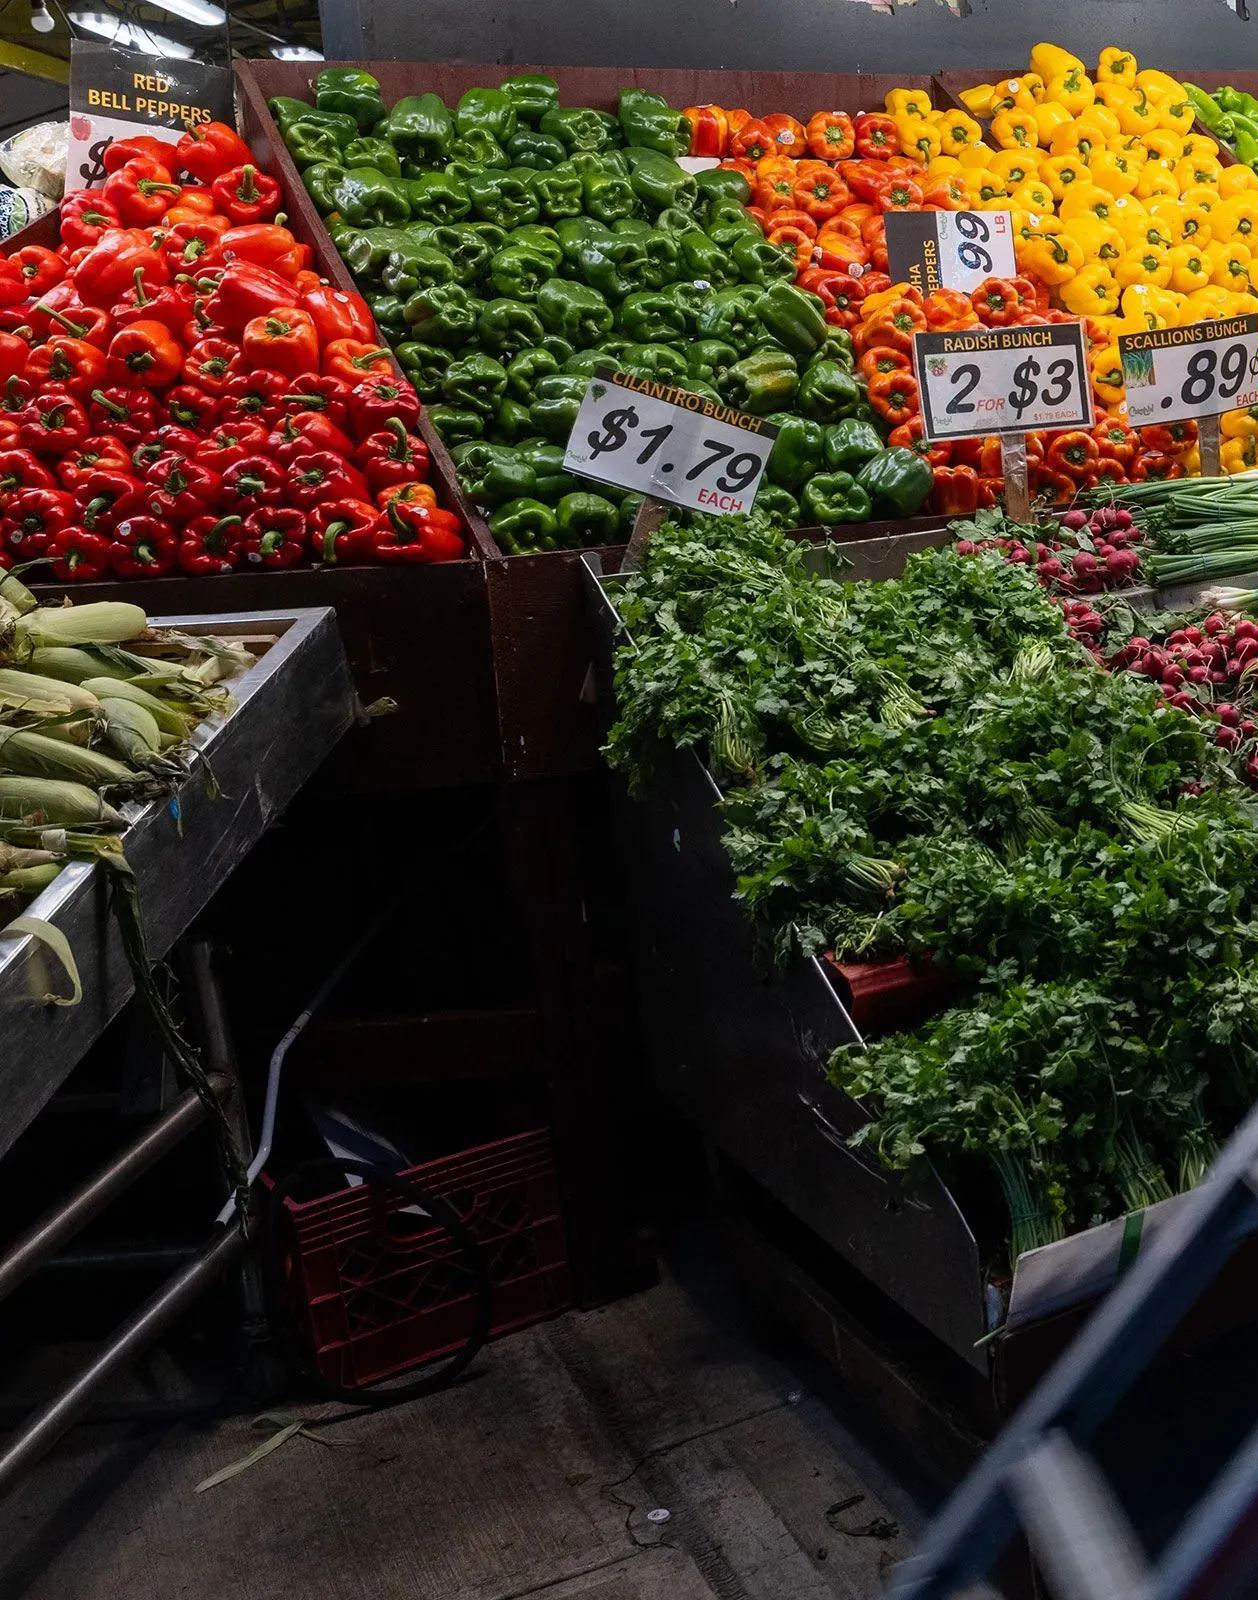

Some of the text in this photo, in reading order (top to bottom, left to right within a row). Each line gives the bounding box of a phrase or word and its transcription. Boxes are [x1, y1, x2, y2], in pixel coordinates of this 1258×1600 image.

[133, 73, 169, 93] RED
[88, 89, 212, 124] BELL PEPPERS
[994, 215, 1006, 234] LB
[923, 239, 939, 297] EPPERS
[943, 331, 1052, 352] RADISH BUNCH
[1125, 320, 1248, 350] SCALLIONS BUNCH
[612, 370, 763, 433] CILANTRO BUNCH
[945, 354, 1074, 420] 2 FOR $3
[1055, 410, 1078, 420] EACH
[587, 405, 763, 494] $1.79
[697, 487, 744, 513] EACH
